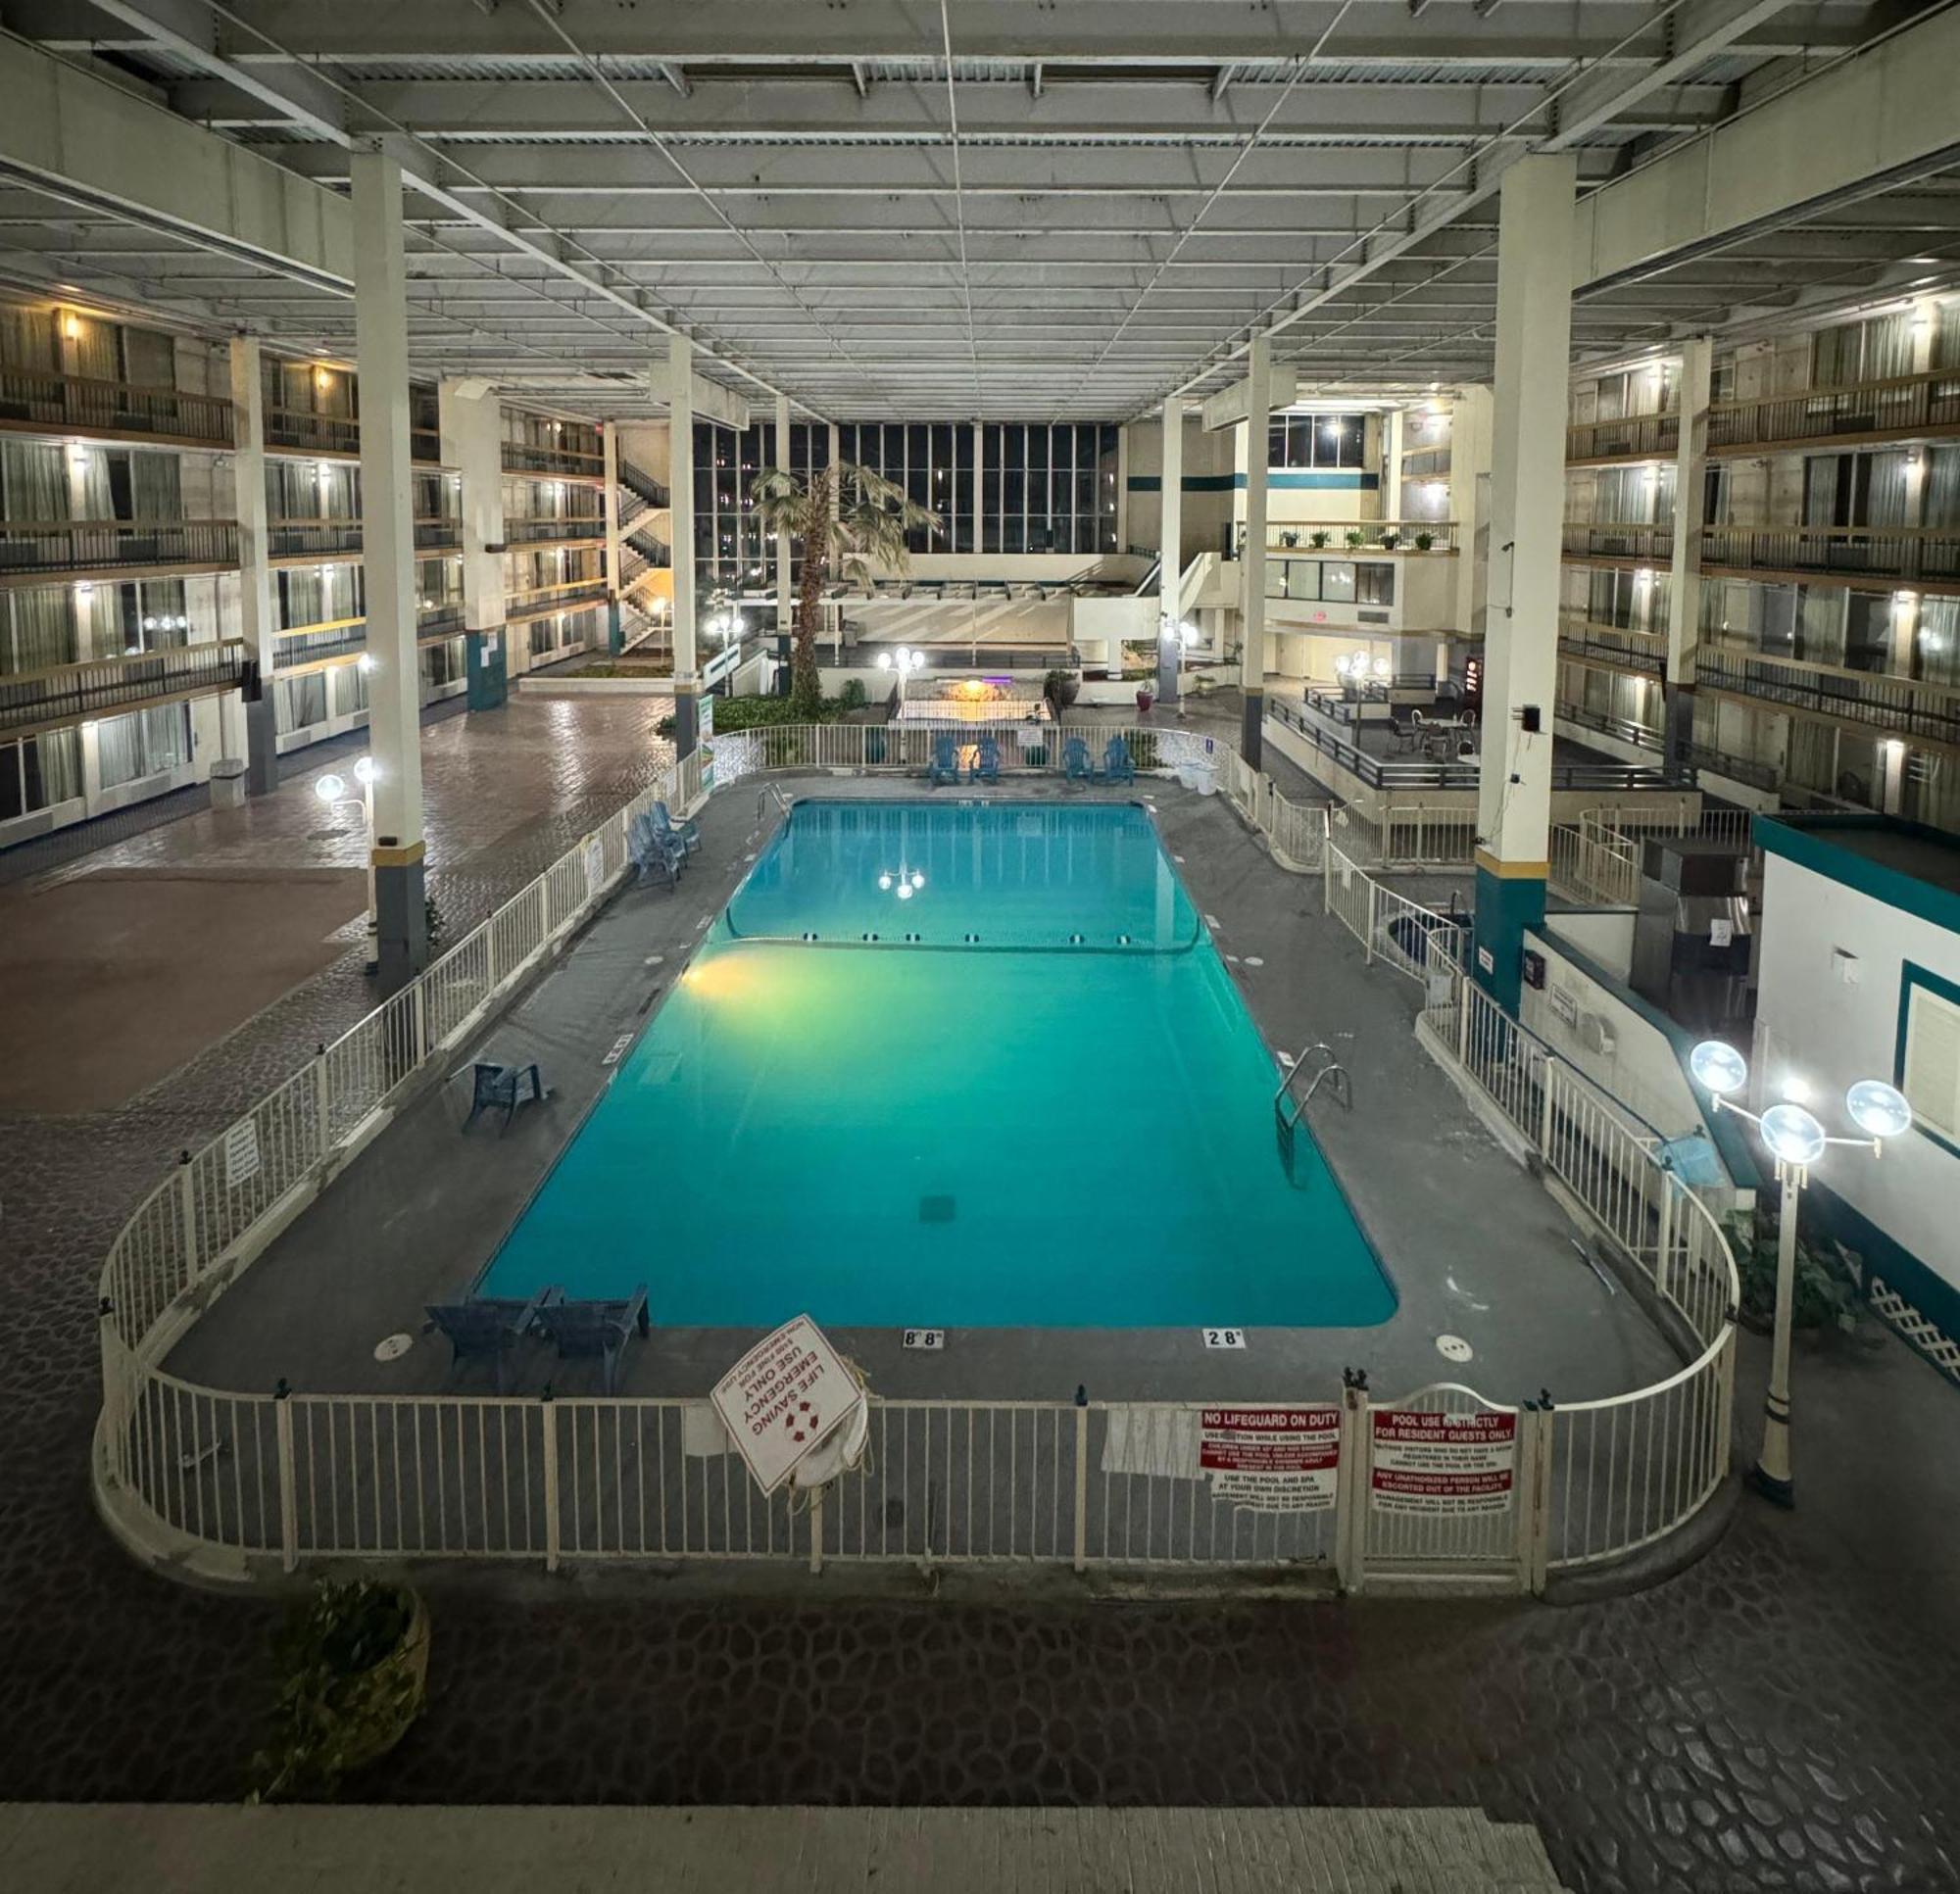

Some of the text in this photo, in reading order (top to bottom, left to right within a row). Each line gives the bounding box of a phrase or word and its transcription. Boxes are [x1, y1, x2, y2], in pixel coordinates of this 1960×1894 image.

[1208, 1332, 1219, 1345] 2
[744, 1345, 803, 1402] USE ONLY
[741, 1350, 817, 1424] EMERGENCY
[751, 1364, 825, 1436] LIFE SAVING
[1204, 1412, 1338, 1427] NO LIFEGUARD ON DUTY
[1392, 1415, 1419, 1427] POOL
[1421, 1416, 1441, 1428] USE
[1375, 1427, 1396, 1437] FOR
[1397, 1429, 1446, 1440] RESIDENT
[1448, 1430, 1488, 1441] GUESTS
